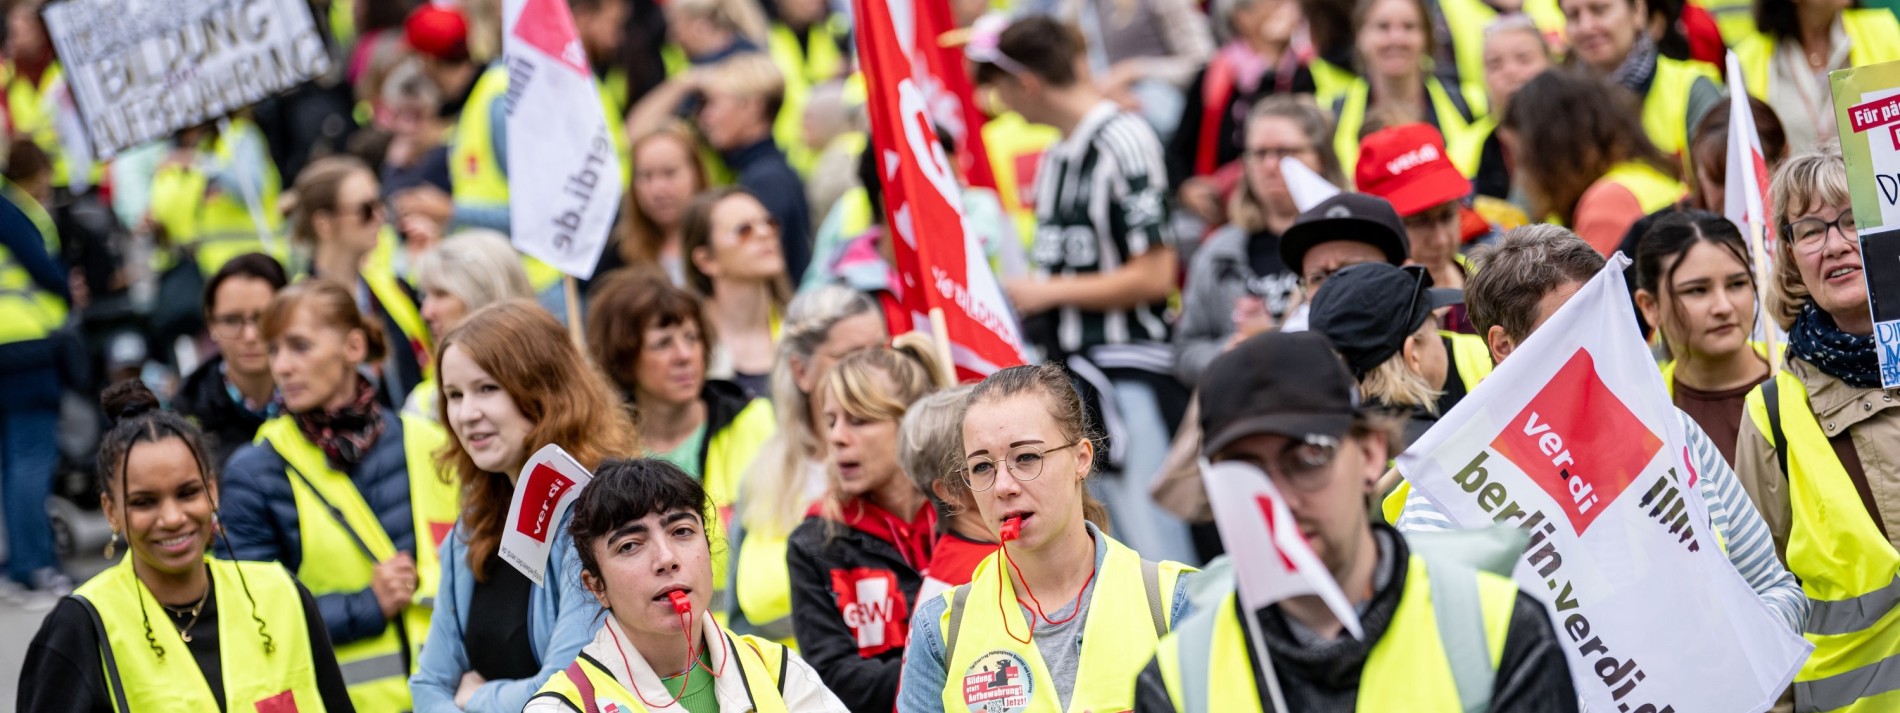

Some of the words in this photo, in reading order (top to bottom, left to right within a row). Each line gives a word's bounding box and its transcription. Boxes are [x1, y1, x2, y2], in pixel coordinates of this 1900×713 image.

[1854, 106, 1879, 127] Für
[1522, 411, 1600, 515] ver.di
[533, 478, 566, 535] ver.di
[966, 673, 993, 686] Bildung
[966, 685, 980, 694] statt
[968, 685, 1023, 703] Aufbewahrung!
